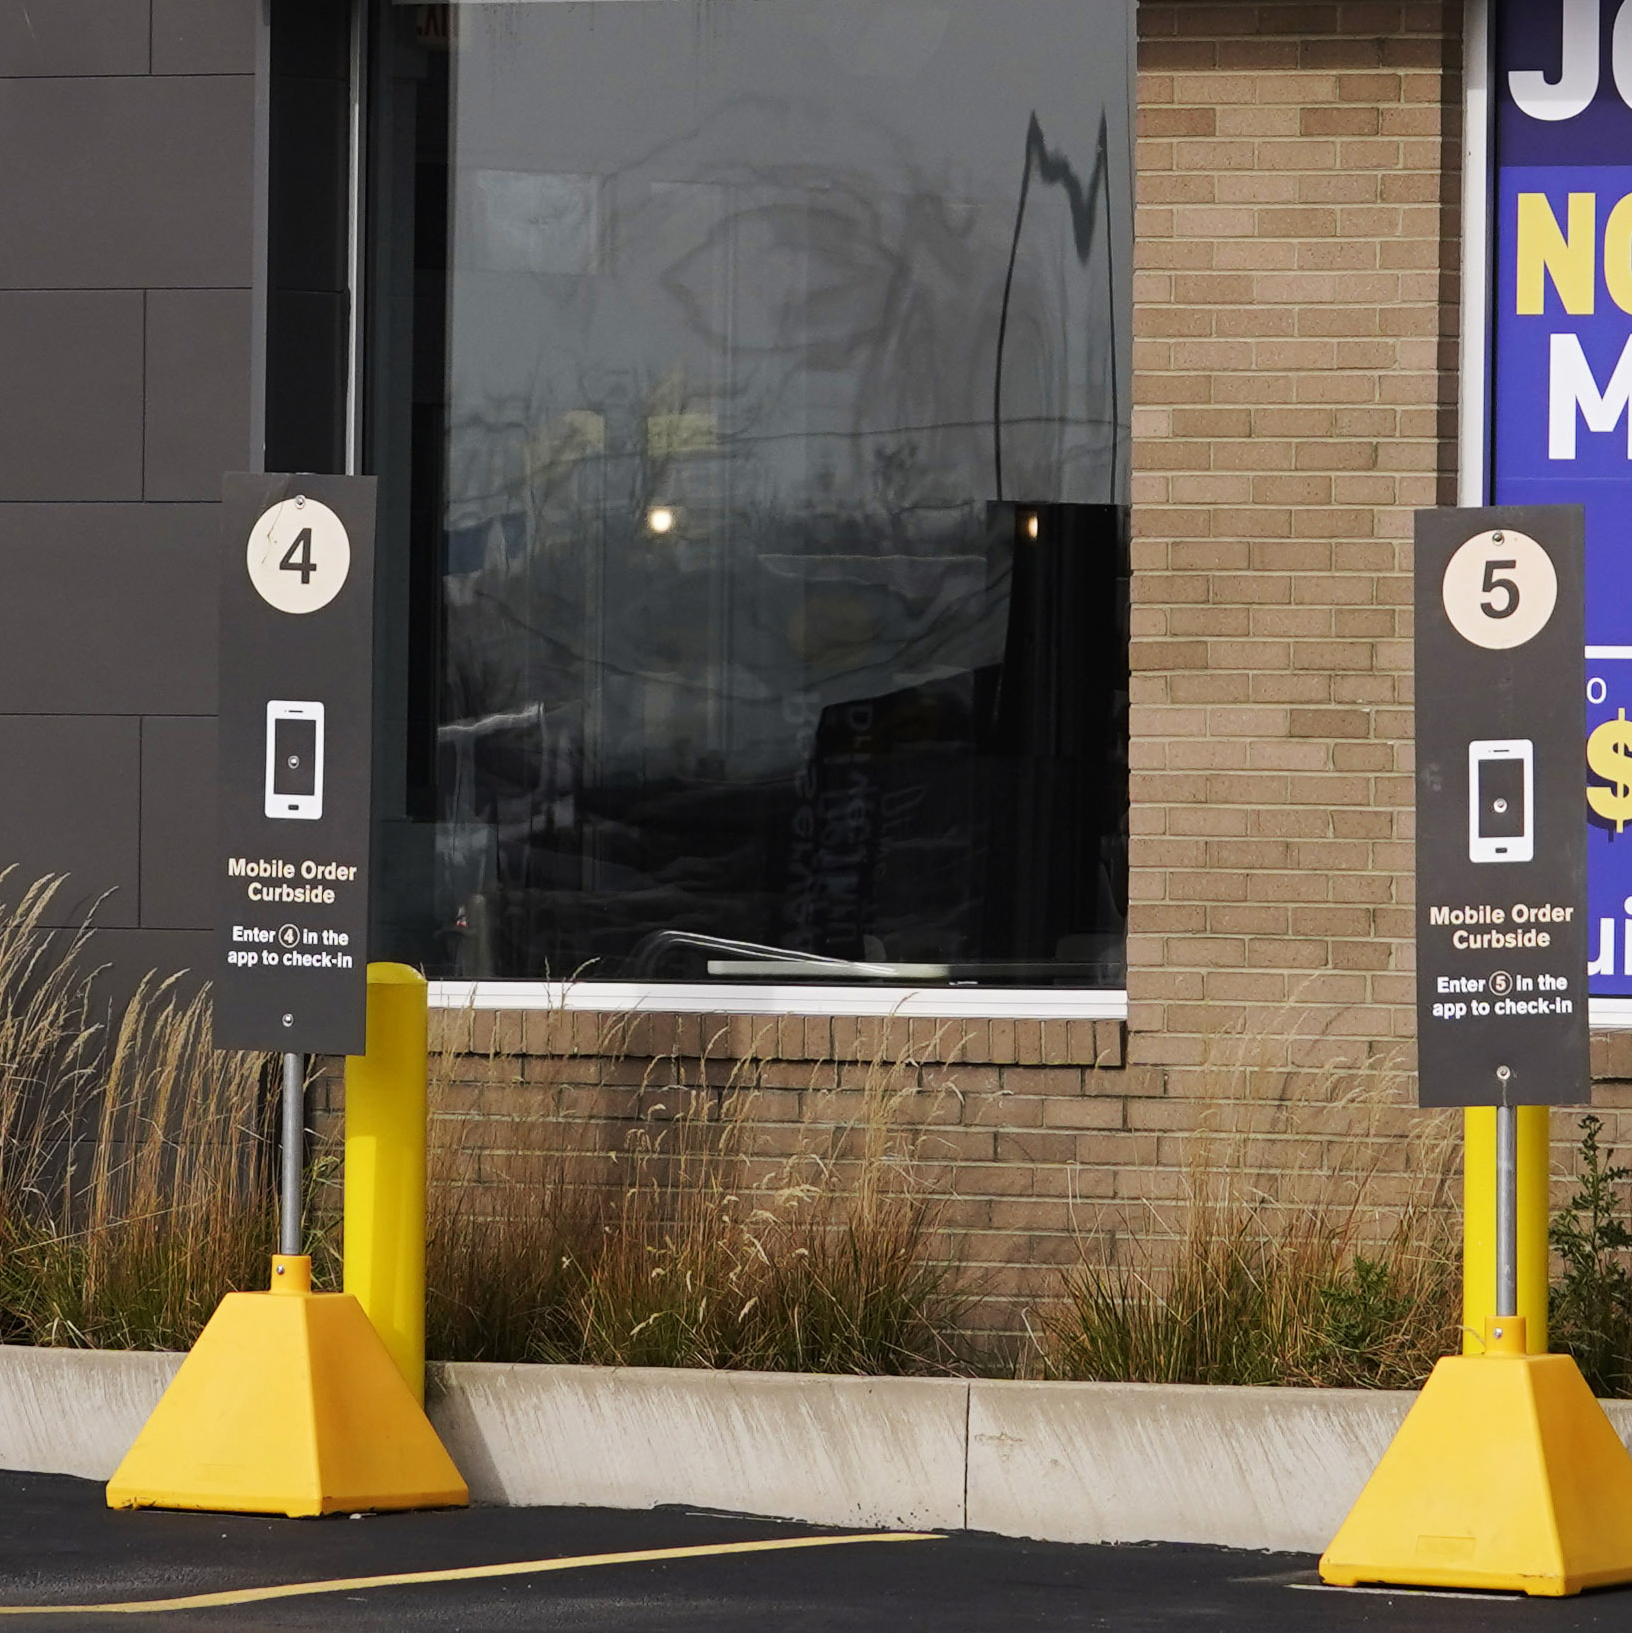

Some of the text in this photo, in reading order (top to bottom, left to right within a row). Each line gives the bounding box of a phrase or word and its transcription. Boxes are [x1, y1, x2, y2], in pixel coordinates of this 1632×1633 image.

[280, 528, 316, 584] 4
[1481, 560, 1519, 619] 5
[229, 858, 357, 881] Mobile Order
[248, 882, 335, 903] Curbside
[1430, 904, 1573, 925] Mobile Order
[233, 926, 276, 942] Enter
[303, 929, 318, 944] in
[322, 930, 348, 945] the
[1453, 929, 1550, 949] Curbside
[228, 948, 352, 968] app to check-in
[1438, 977, 1486, 993] Enter
[1517, 975, 1533, 991] in
[1538, 974, 1567, 990] the
[1433, 997, 1572, 1019] app to check-in
